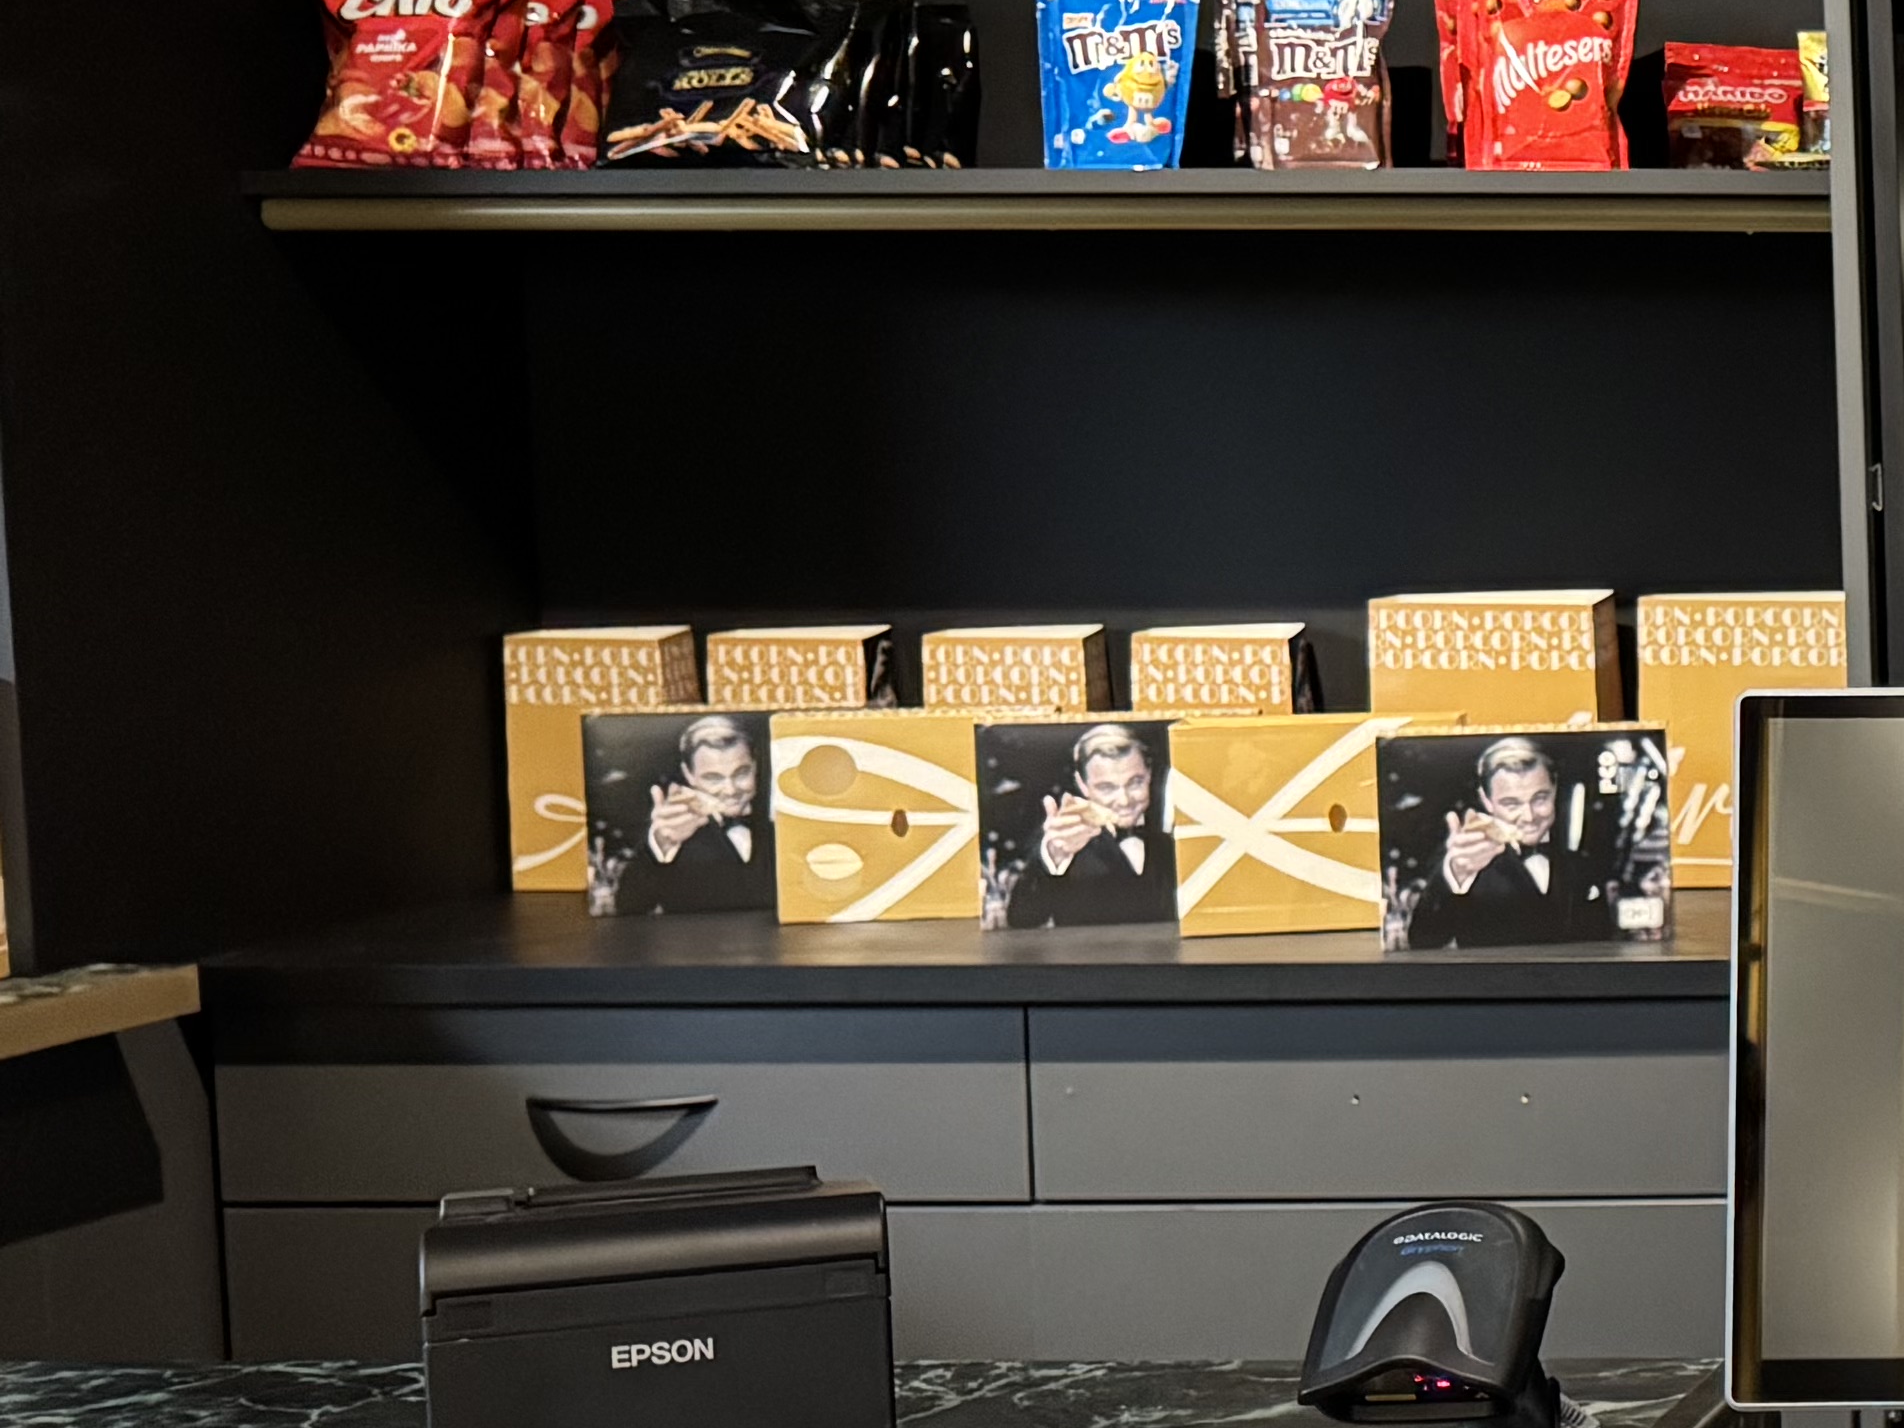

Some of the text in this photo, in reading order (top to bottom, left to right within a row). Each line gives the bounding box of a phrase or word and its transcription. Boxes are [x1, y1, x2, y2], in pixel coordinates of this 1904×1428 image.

[1706, 607, 1839, 627] POPCORN
[1417, 630, 1548, 650] POPCORN
[1640, 626, 1769, 647] POPCORN
[611, 1337, 714, 1369] EPSON
